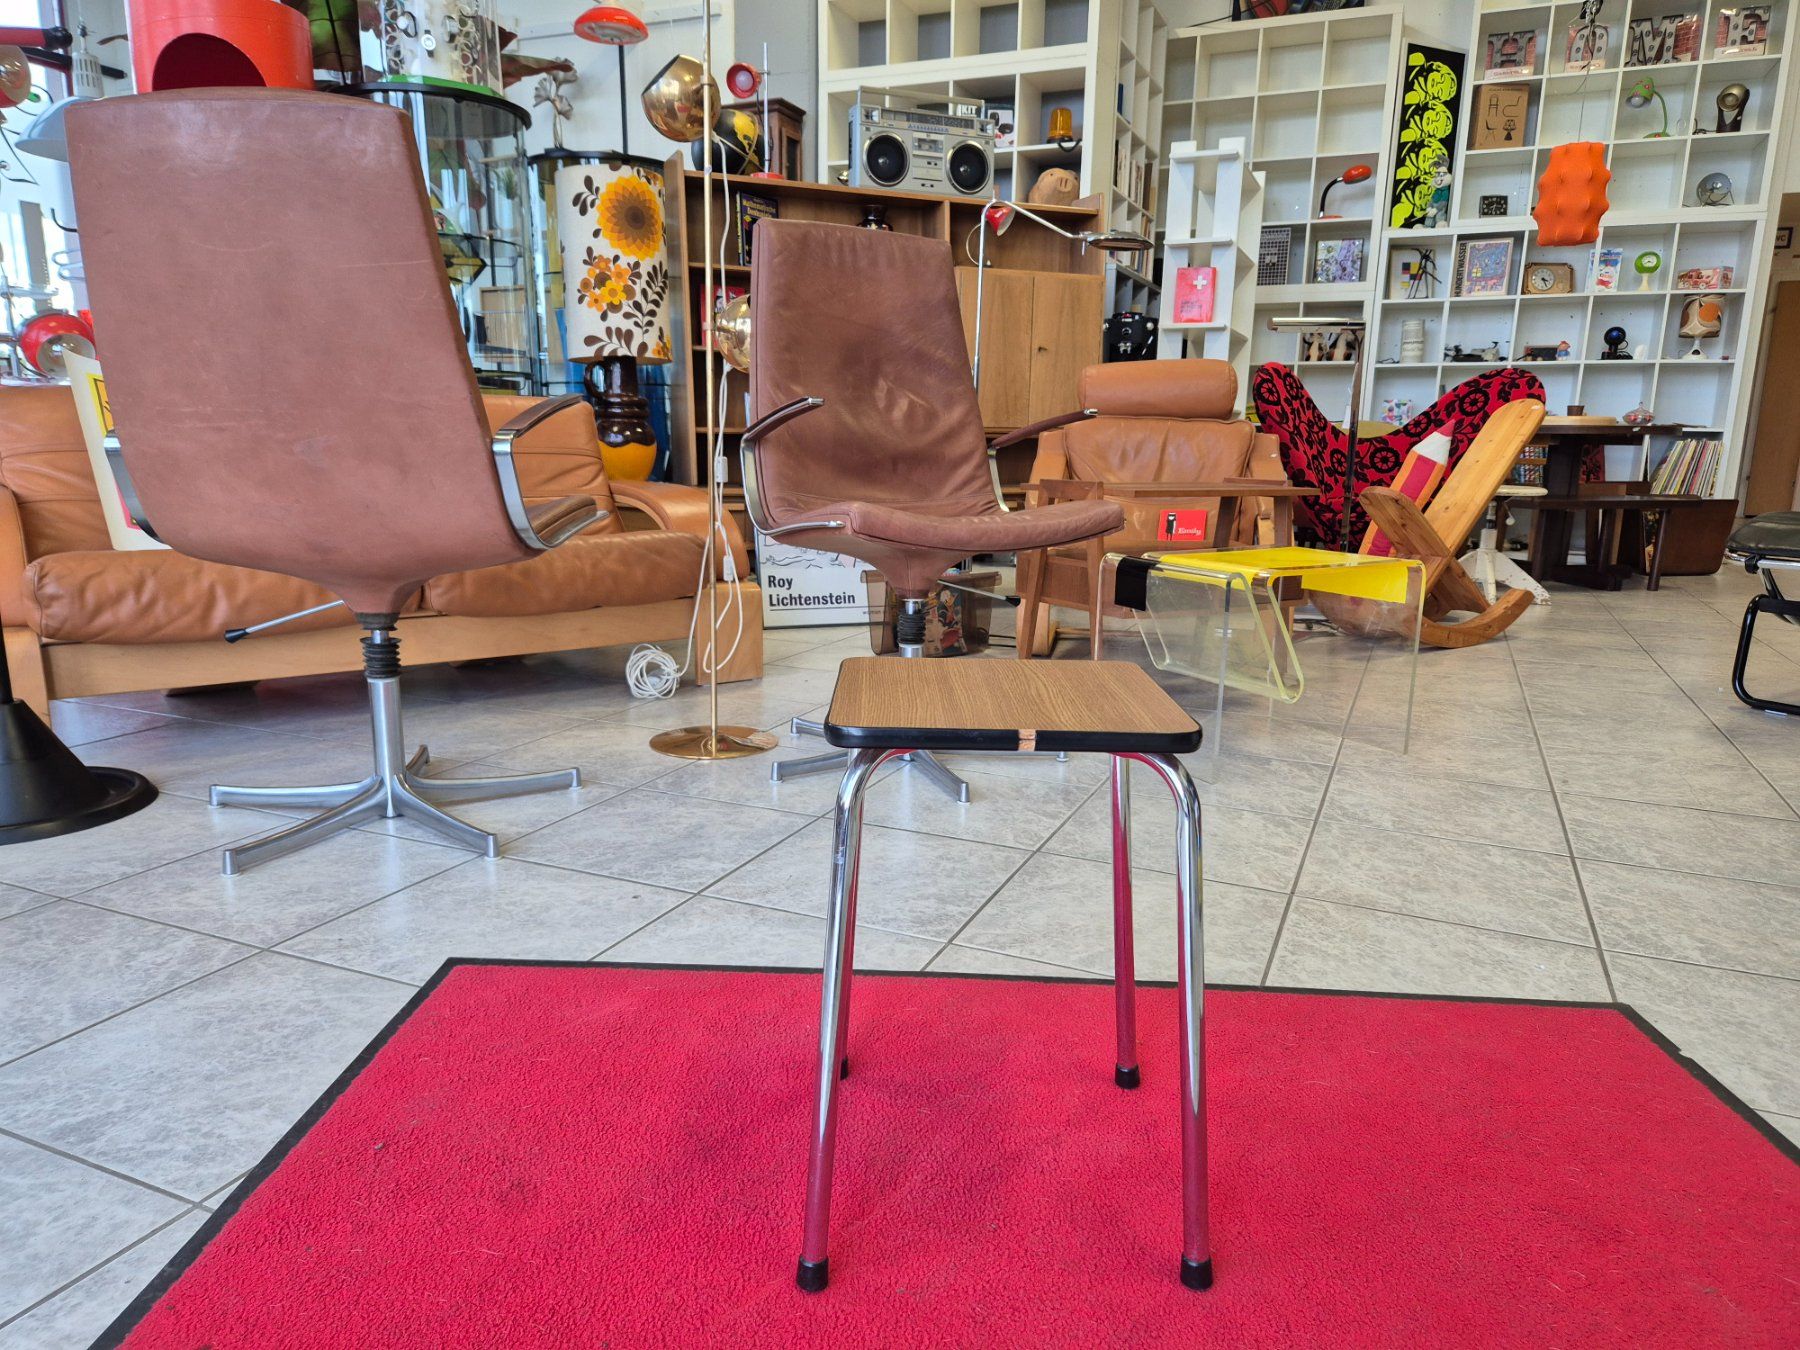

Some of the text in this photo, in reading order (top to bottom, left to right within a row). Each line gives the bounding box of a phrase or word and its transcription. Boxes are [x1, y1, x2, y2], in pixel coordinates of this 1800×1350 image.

[1454, 242, 1467, 297] HUNDERTWASSER
[767, 575, 793, 590] Roy
[769, 592, 856, 607] Lichtenstein
